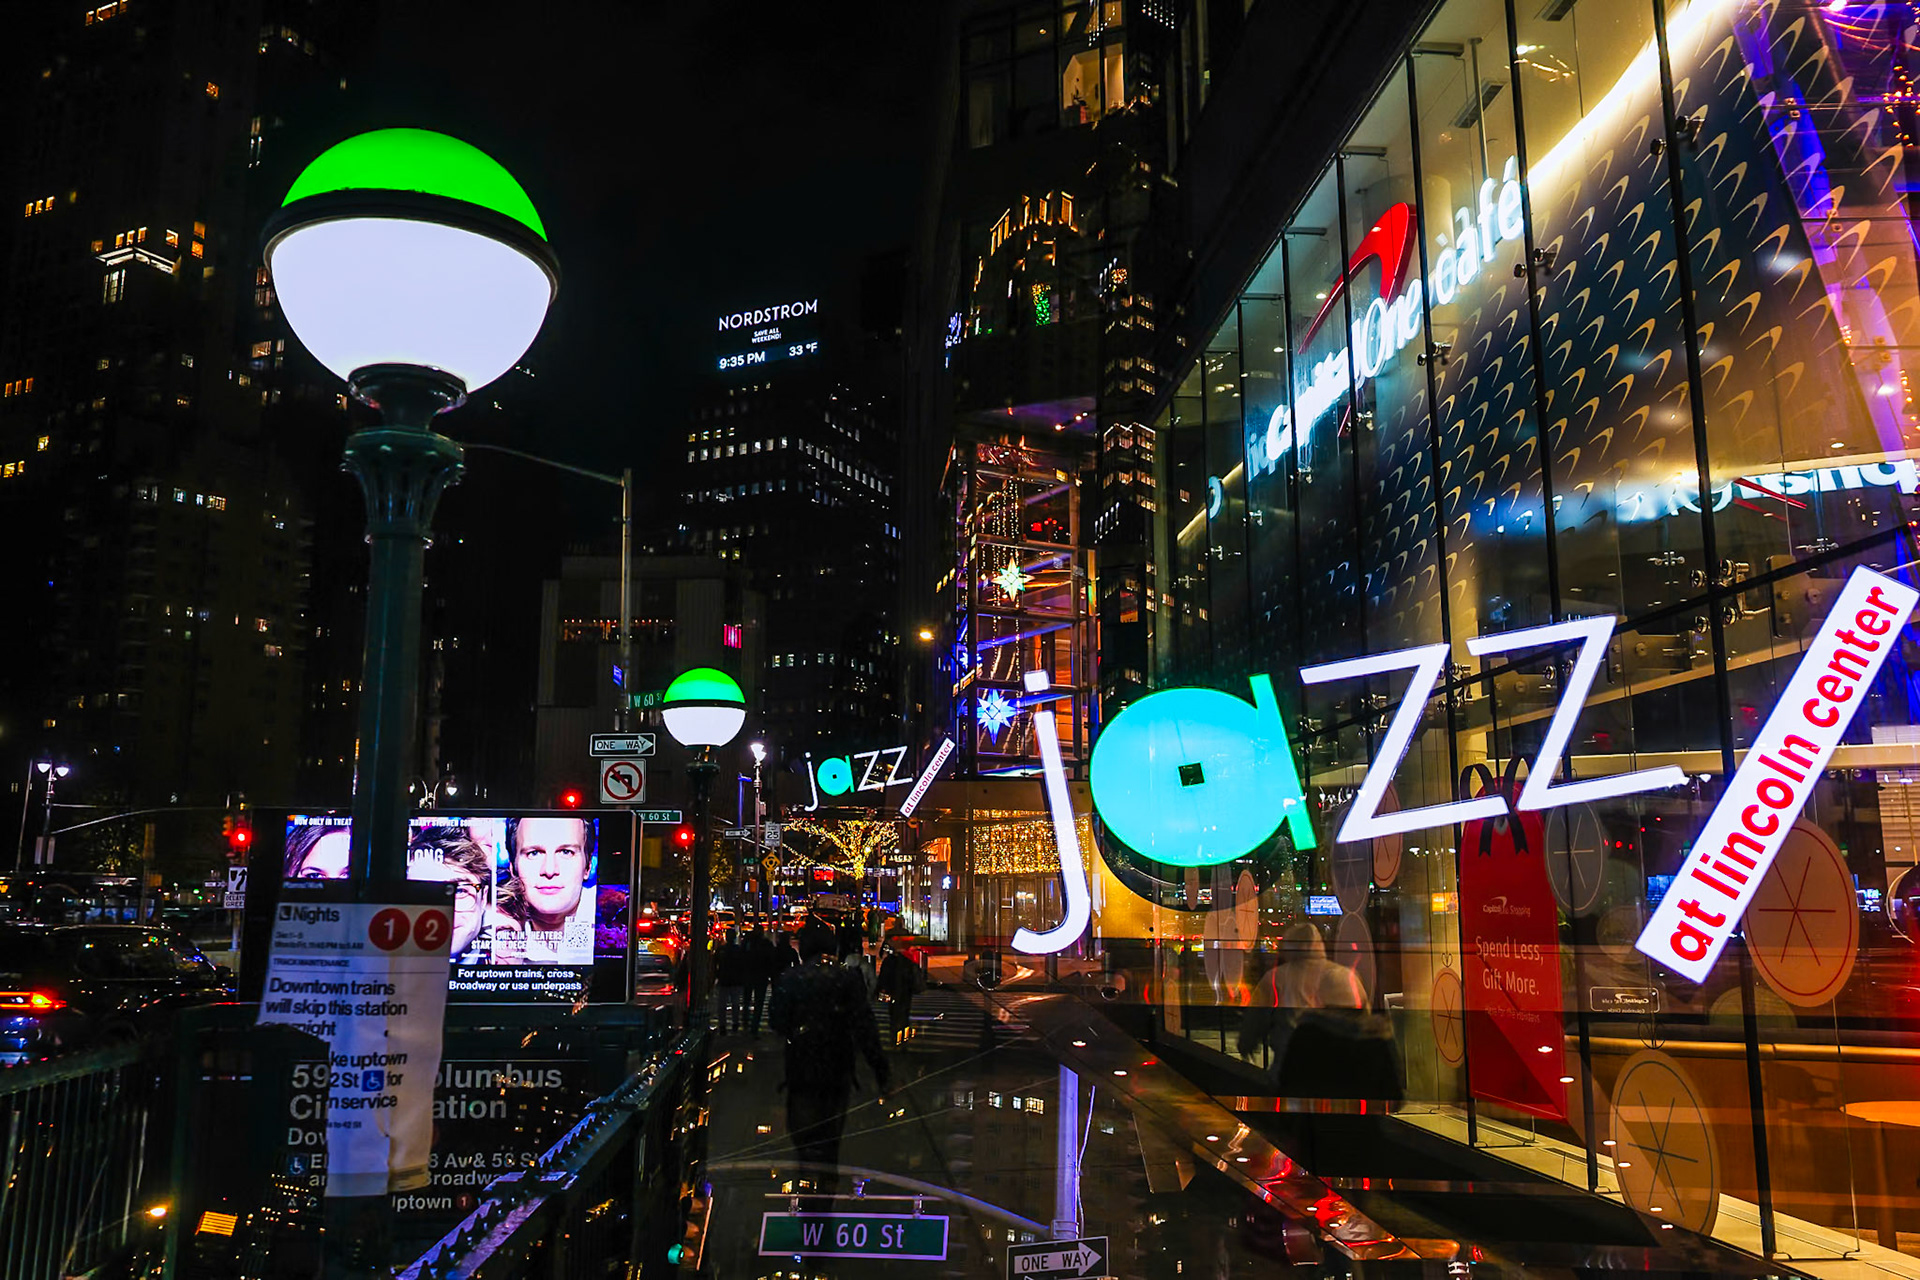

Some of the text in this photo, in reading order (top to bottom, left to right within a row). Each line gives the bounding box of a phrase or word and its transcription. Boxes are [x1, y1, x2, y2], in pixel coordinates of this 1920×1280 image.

[718, 299, 818, 331] NORDSTROM
[769, 327, 779, 335] ALL
[719, 354, 744, 369] 9:35
[747, 351, 765, 364] PM
[789, 345, 803, 356] 33
[634, 695, 641, 708] W
[644, 694, 654, 706] 60
[596, 741, 646, 749] ONE WAY
[804, 745, 913, 812] jazz
[905, 742, 951, 814] at lincoln center
[1670, 586, 1899, 962] at lincoln center
[1011, 616, 1686, 953] jazz
[294, 818, 308, 826] NOW
[309, 818, 324, 826] ONLY
[325, 818, 333, 826] IN
[649, 812, 660, 821] 60
[662, 812, 670, 821] St
[767, 831, 779, 839] 25
[293, 906, 340, 924] Nights
[384, 918, 438, 941] 1 2
[528, 931, 563, 940] HEATERS
[1475, 936, 1544, 966] Spend Less,
[458, 969, 573, 980] For uptown trains, cross
[1482, 968, 1540, 996] Gift More.
[269, 978, 396, 996] Downtown trains
[449, 981, 582, 992] Broadway or use underpass
[265, 998, 407, 1018] will skip this station
[350, 1052, 407, 1070] uptown
[342, 1072, 359, 1088] St
[386, 1071, 404, 1086] for
[340, 1093, 398, 1109] service
[444, 1153, 468, 1168] Av
[473, 1153, 486, 1168] &
[803, 1223, 905, 1249] W 60 St
[1021, 1251, 1093, 1271] ONE WAY
